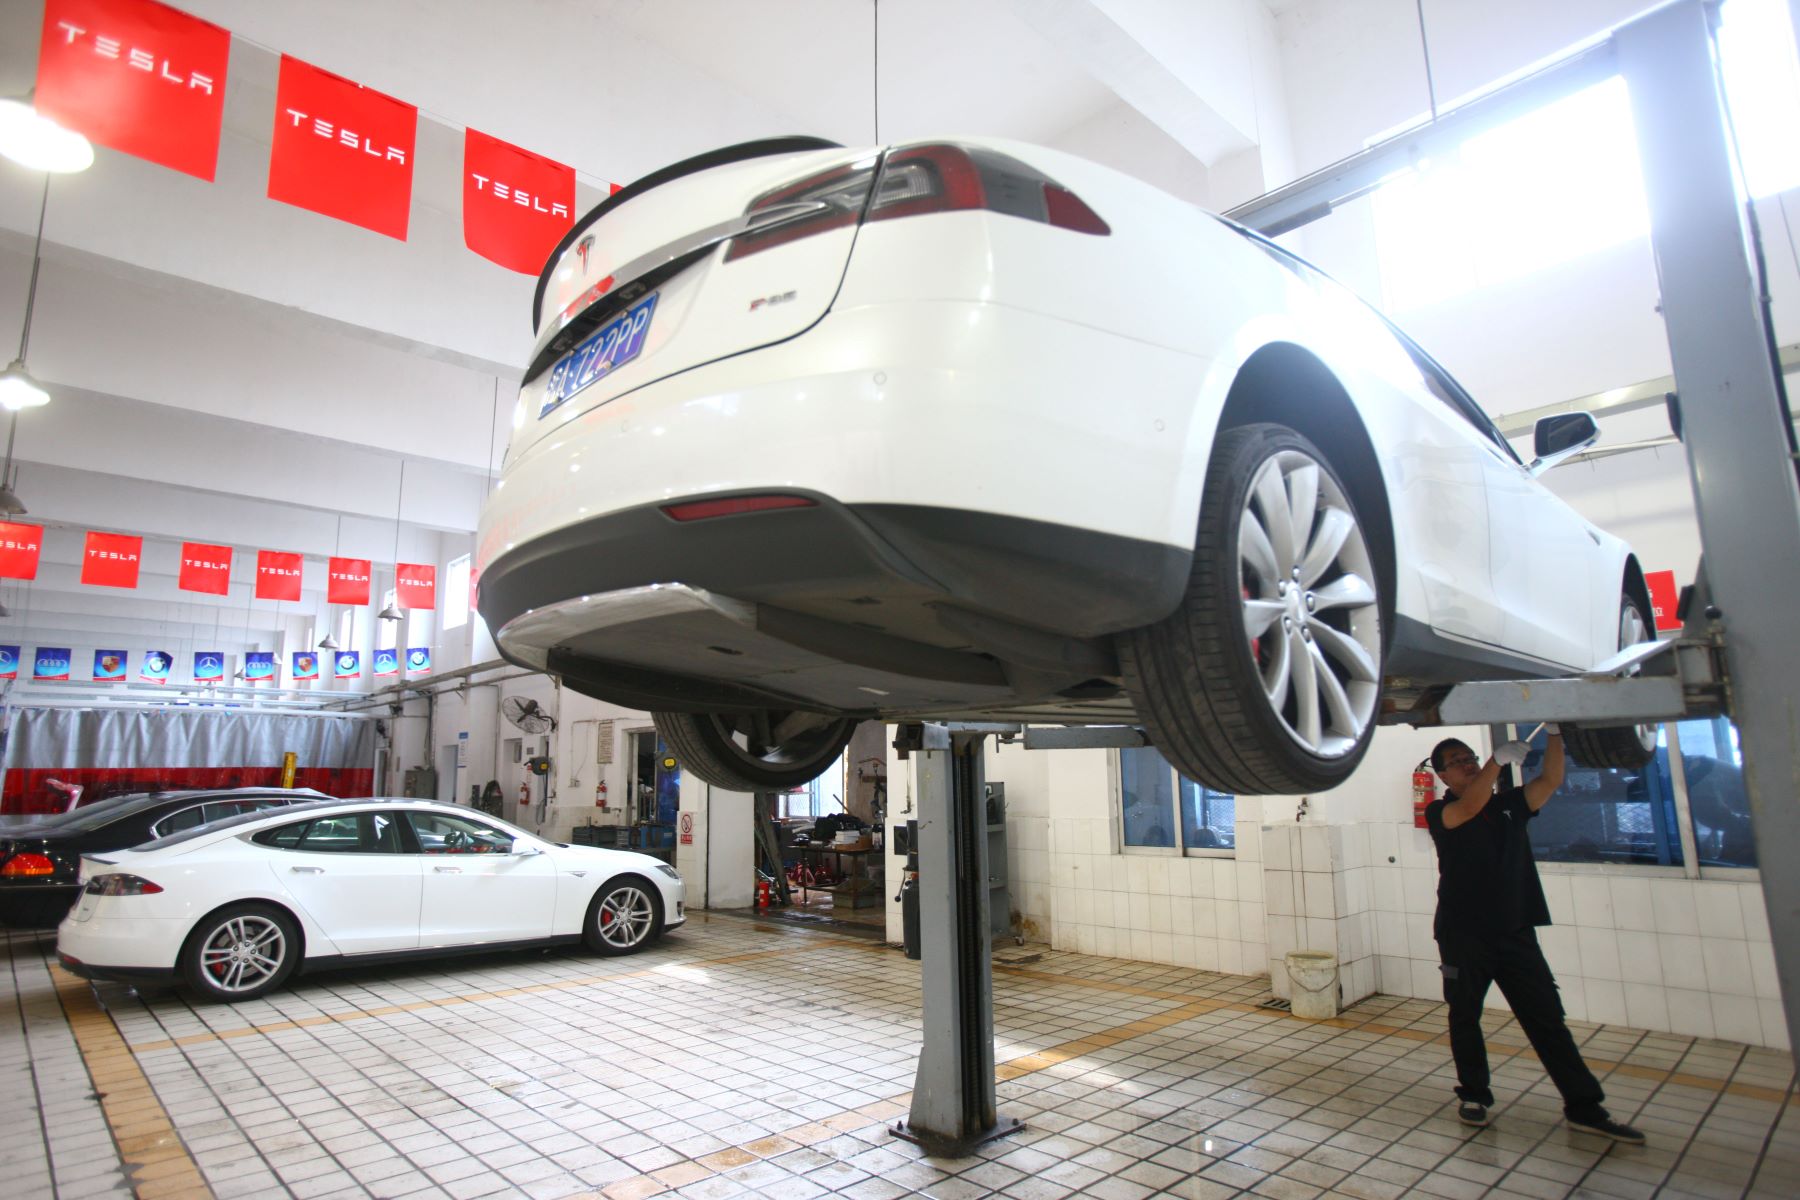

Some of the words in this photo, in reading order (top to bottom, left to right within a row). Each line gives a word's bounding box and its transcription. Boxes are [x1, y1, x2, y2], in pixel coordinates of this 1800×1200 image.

[58, 20, 214, 95] TESLA
[286, 108, 405, 165] TESLA
[472, 173, 567, 218] TESLA
[89, 550, 137, 561] TESLA
[185, 559, 228, 570] TESLA
[260, 567, 300, 577] TESLA
[331, 572, 369, 582] TESLA
[399, 578, 433, 587] TESLA
